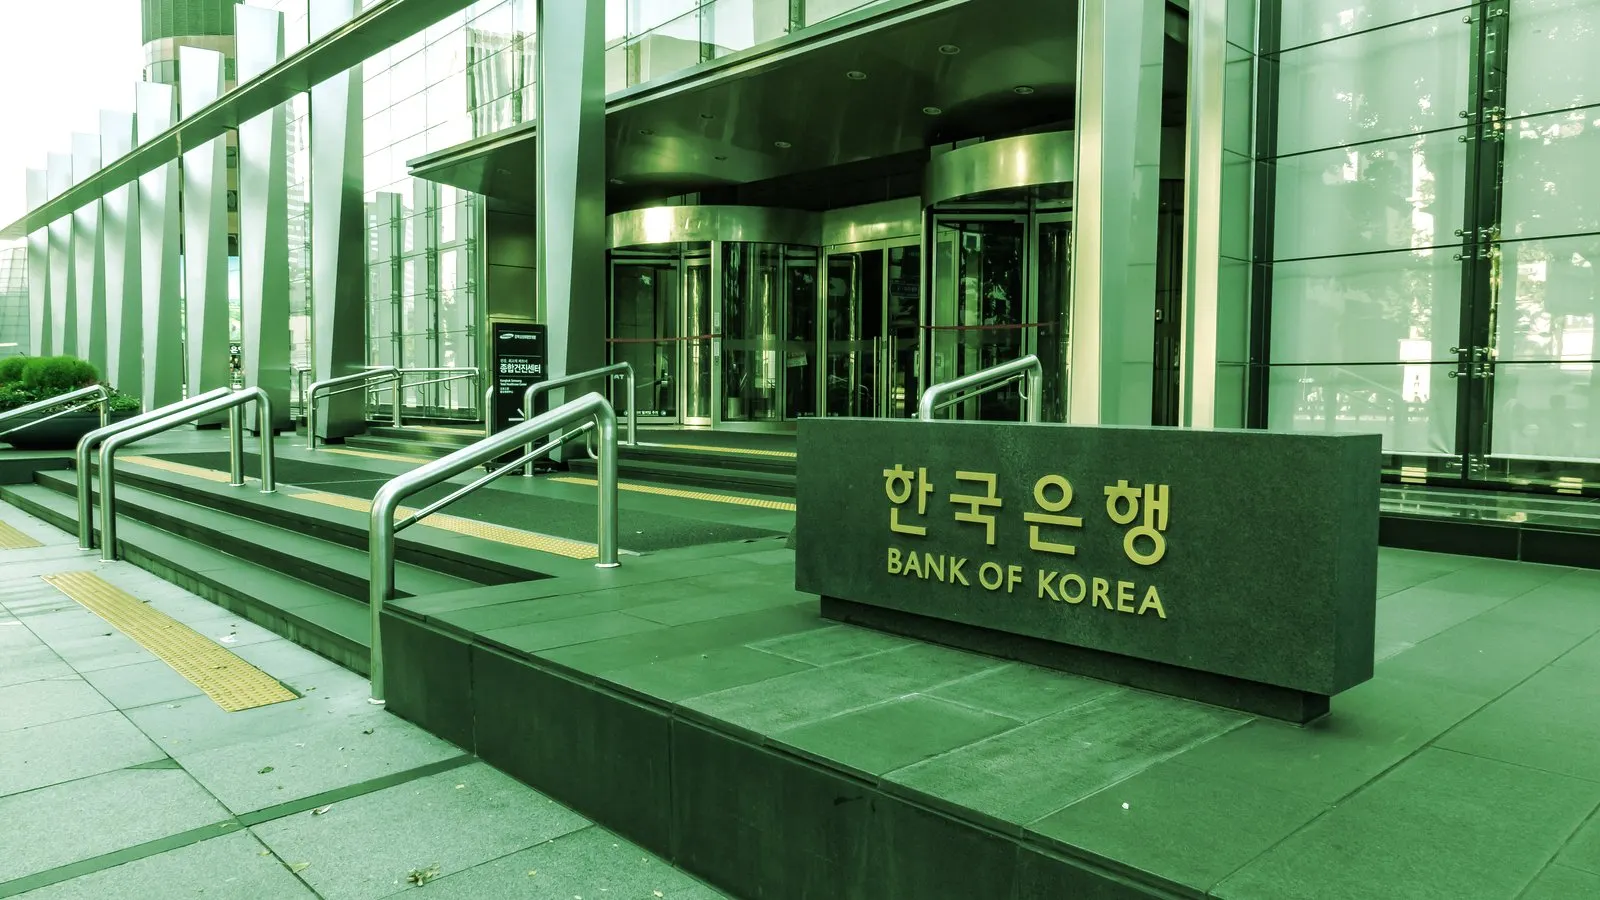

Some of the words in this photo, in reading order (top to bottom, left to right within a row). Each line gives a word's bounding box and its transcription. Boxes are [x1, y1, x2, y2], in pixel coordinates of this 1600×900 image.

[500, 363, 541, 374] 종합건진센터
[883, 463, 1169, 566] 한국은행
[887, 547, 970, 586] BANK
[978, 561, 1022, 593] OF
[1038, 569, 1167, 619] KOREA
